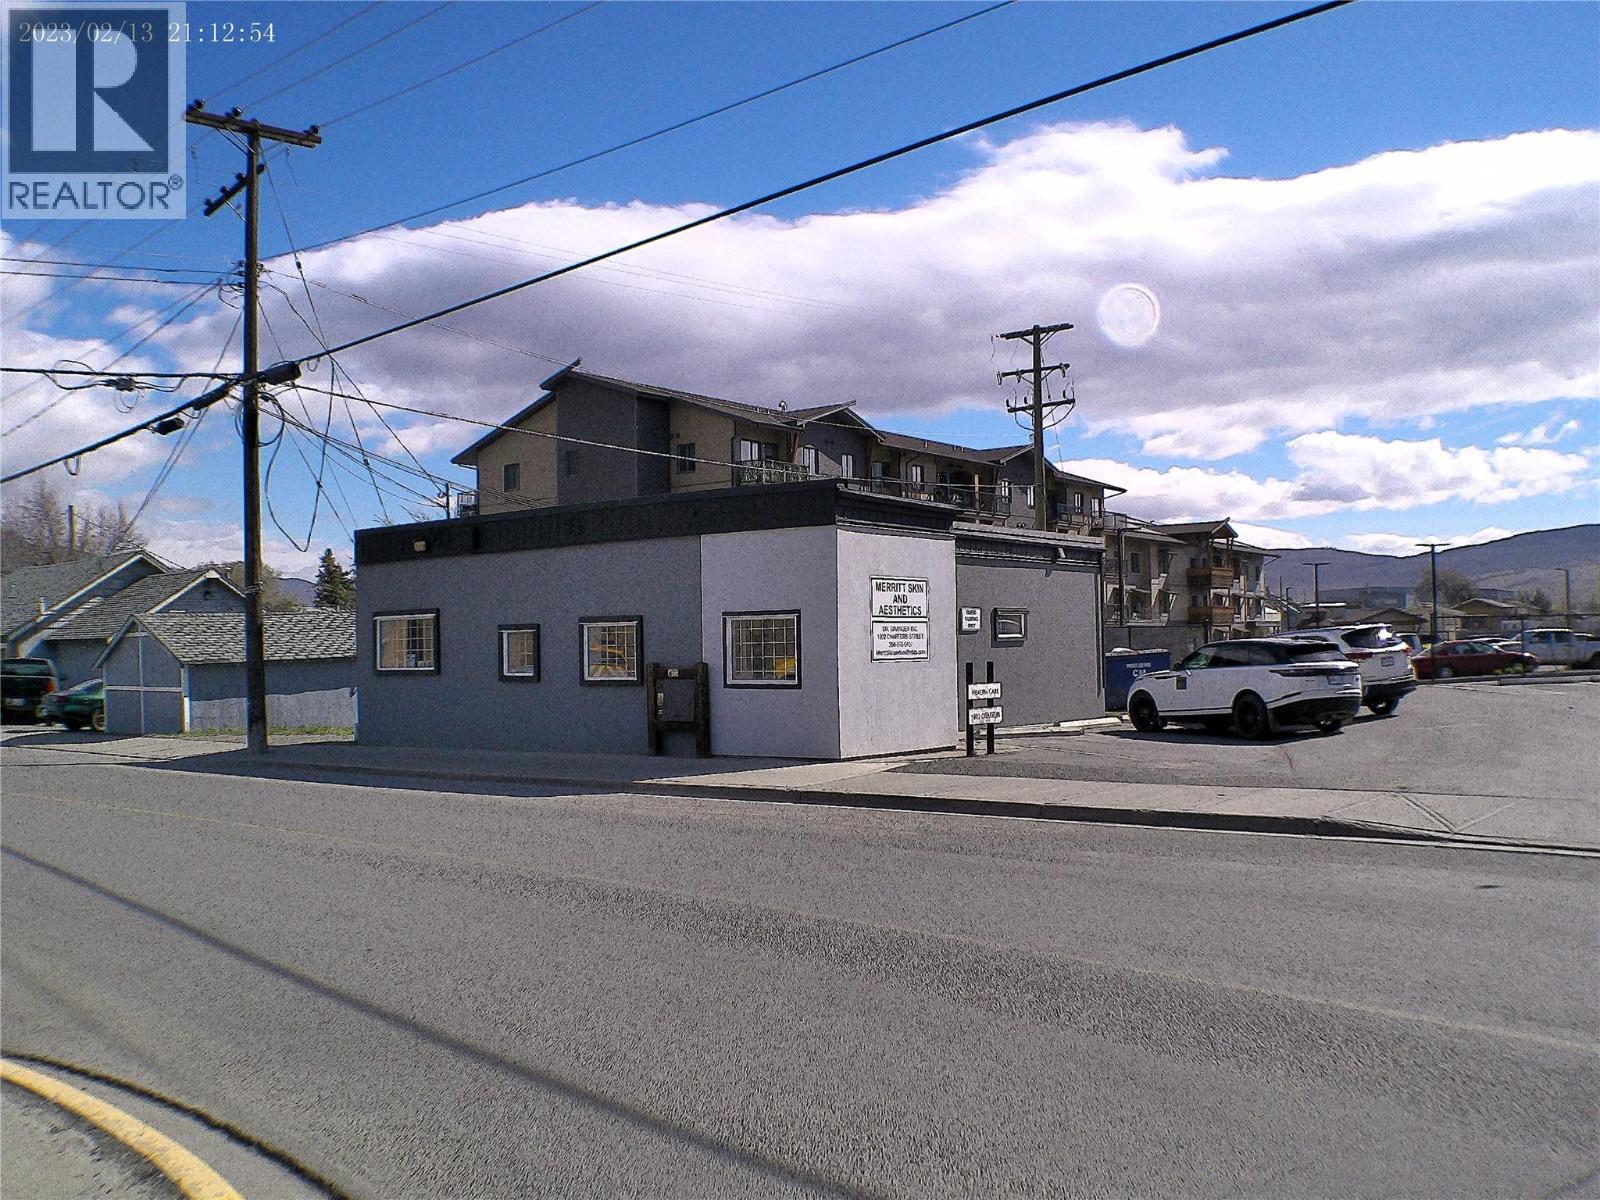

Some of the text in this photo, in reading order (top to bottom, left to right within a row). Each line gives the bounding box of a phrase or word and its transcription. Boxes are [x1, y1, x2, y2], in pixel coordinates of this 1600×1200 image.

[875, 581, 924, 594] MERRITT SKIN
[892, 594, 908, 604] AND
[878, 605, 922, 616] AESTHETICS
